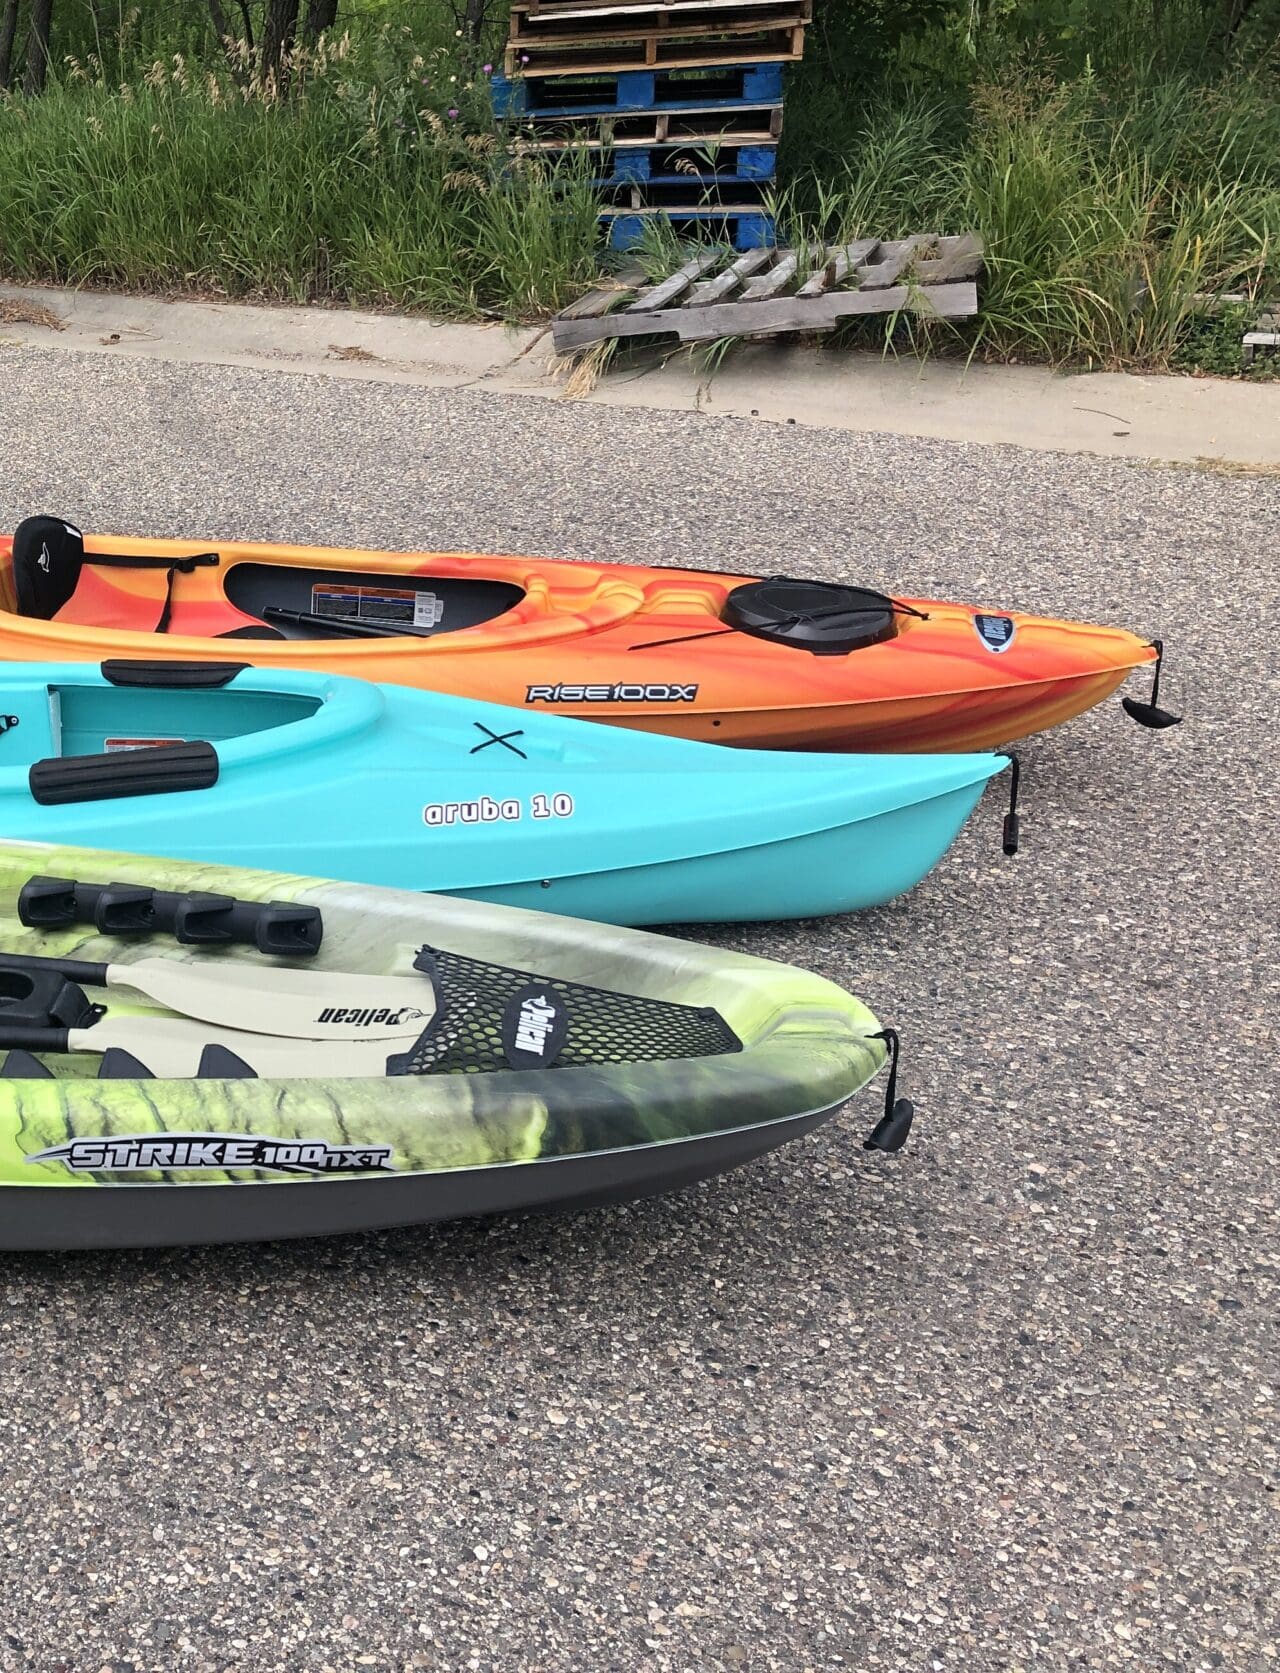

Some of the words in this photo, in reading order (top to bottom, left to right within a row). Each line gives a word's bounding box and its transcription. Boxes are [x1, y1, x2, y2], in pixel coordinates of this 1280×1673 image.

[424, 797, 520, 826] aruba
[532, 793, 573, 818] 10
[317, 1008, 408, 1027] Pelican
[515, 998, 556, 1056] Pelican
[71, 1141, 259, 1167] STRIKE
